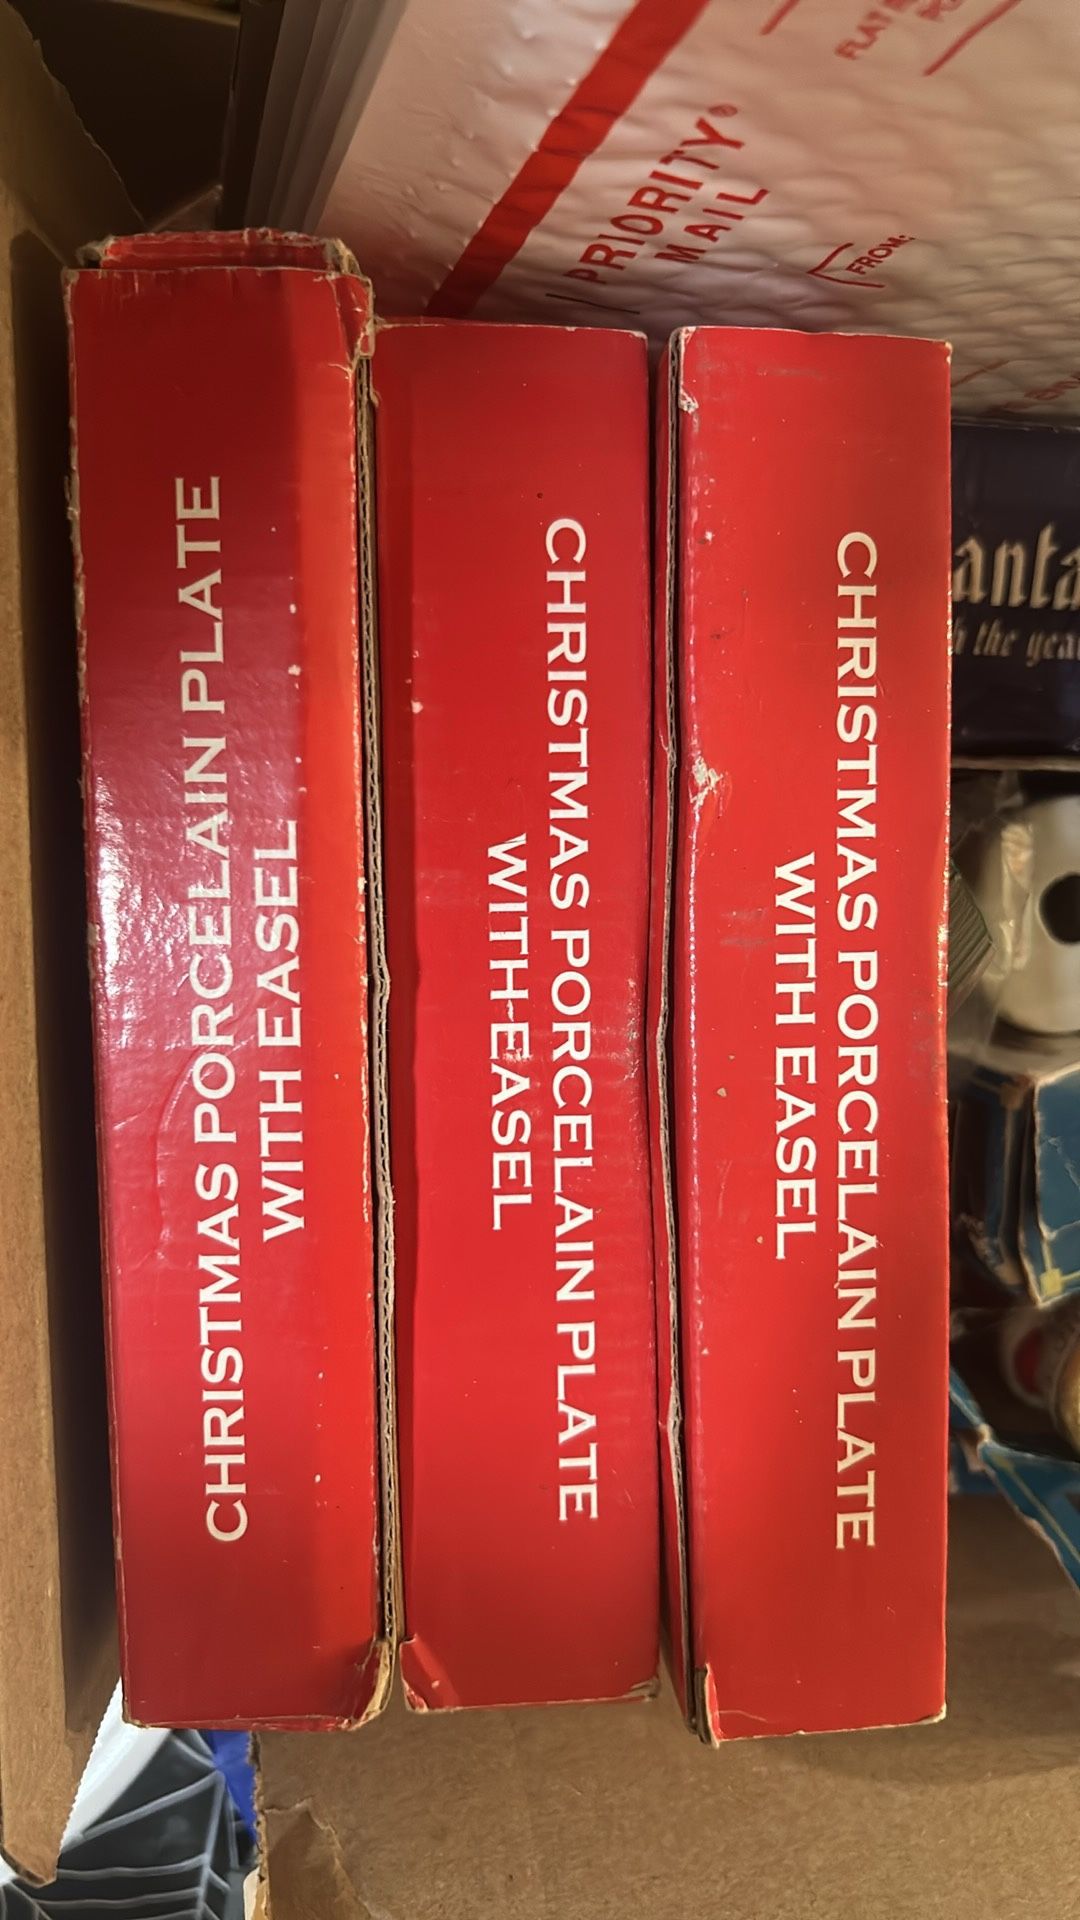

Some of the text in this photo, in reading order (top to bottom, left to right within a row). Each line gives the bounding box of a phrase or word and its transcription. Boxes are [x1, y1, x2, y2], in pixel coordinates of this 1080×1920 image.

[654, 188, 770, 264] MAIL
[845, 233, 917, 275] FROM:
[972, 618, 1019, 657] the
[174, 475, 248, 1542] CHRISTMAS PORCELAIN PLATE
[251, 819, 305, 1242] WITH EASEL
[487, 833, 534, 1231] WITH EASEL
[546, 518, 599, 1522] CHRISTMAS PORCELAIN PLATE
[774, 852, 818, 1260] WITH EASEL
[836, 531, 879, 1549] CHRISTMAS PORCELAIN PLATE
